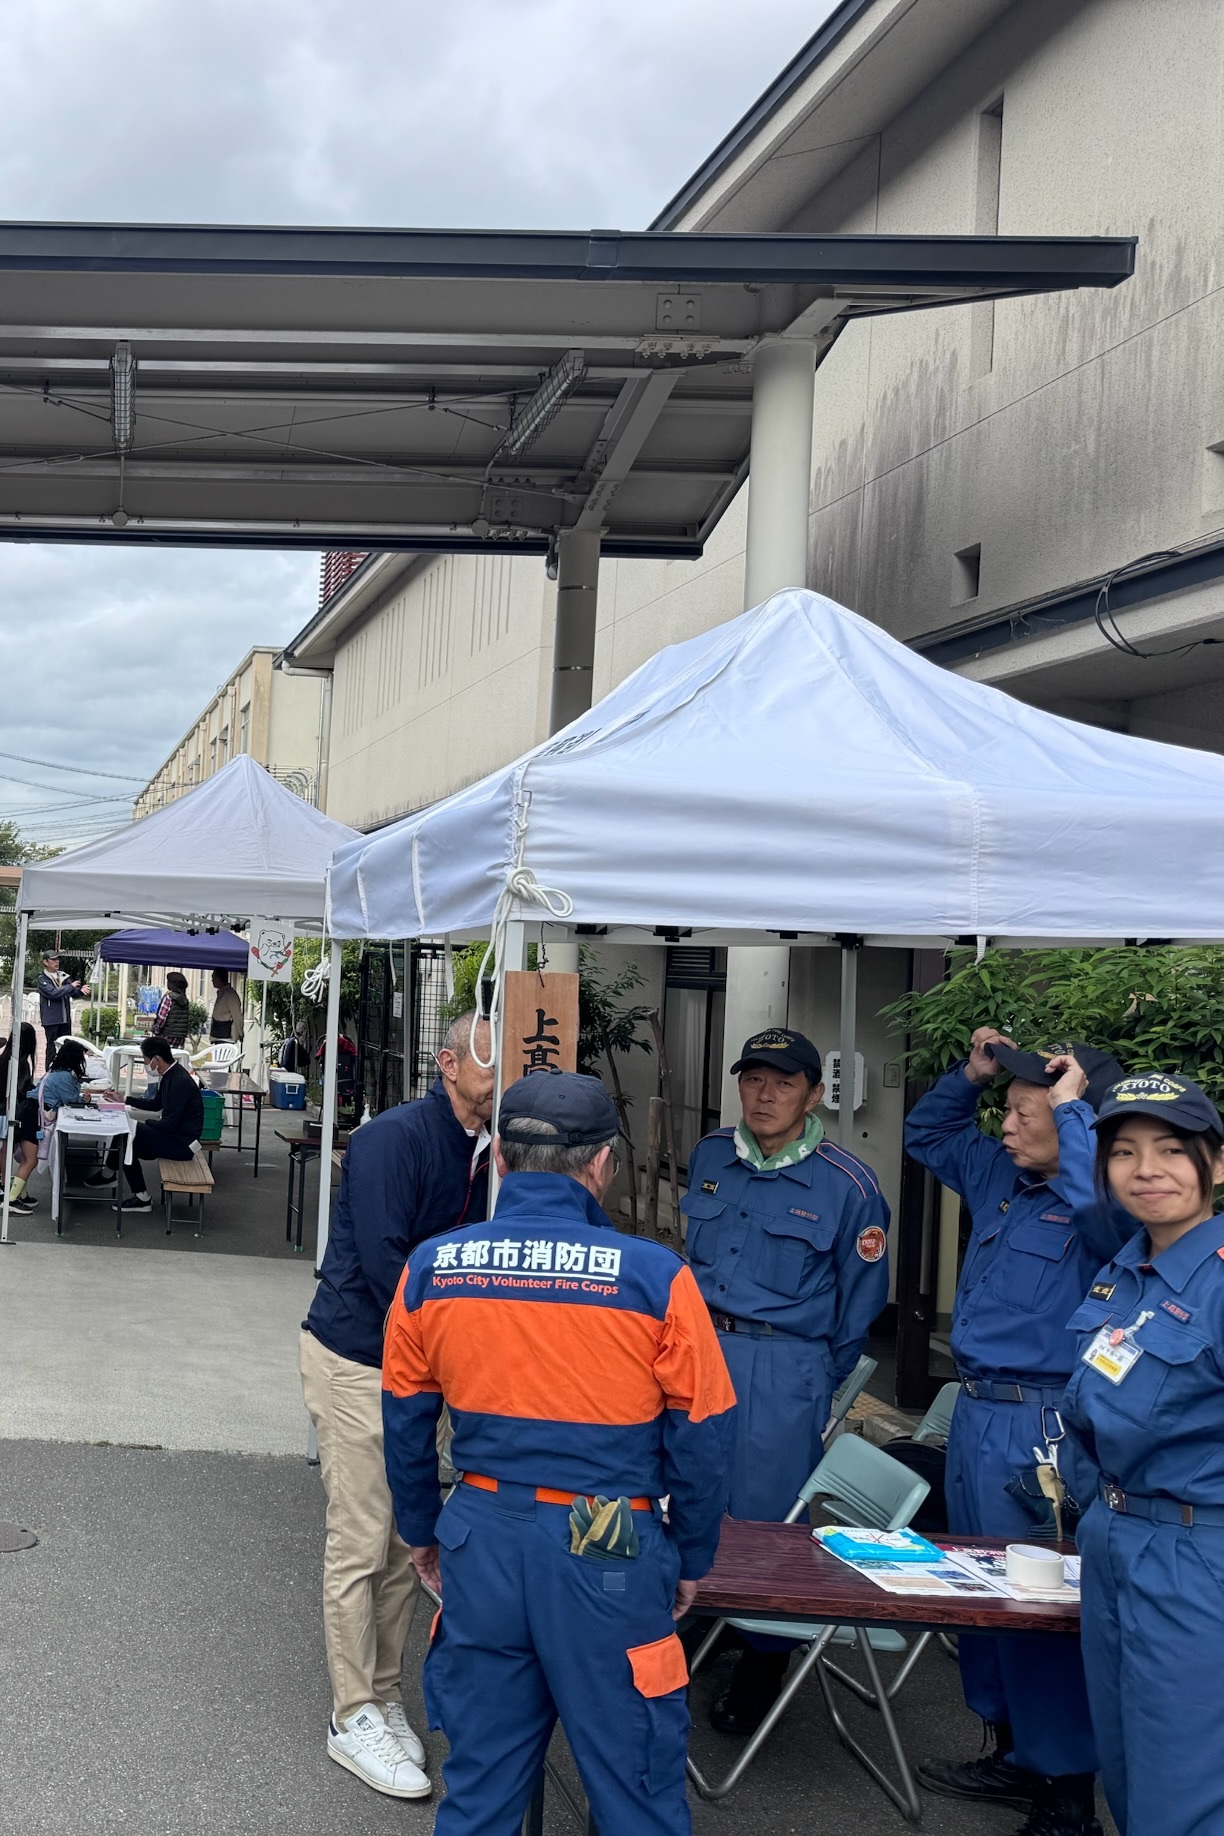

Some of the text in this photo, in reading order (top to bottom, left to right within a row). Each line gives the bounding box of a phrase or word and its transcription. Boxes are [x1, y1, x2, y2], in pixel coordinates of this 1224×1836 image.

[1119, 1079, 1171, 1093] KYOTO
[432, 1238, 622, 1276] 京都市消防団
[432, 1274, 619, 1296] Kyoto City Volunteer Fire Corps
